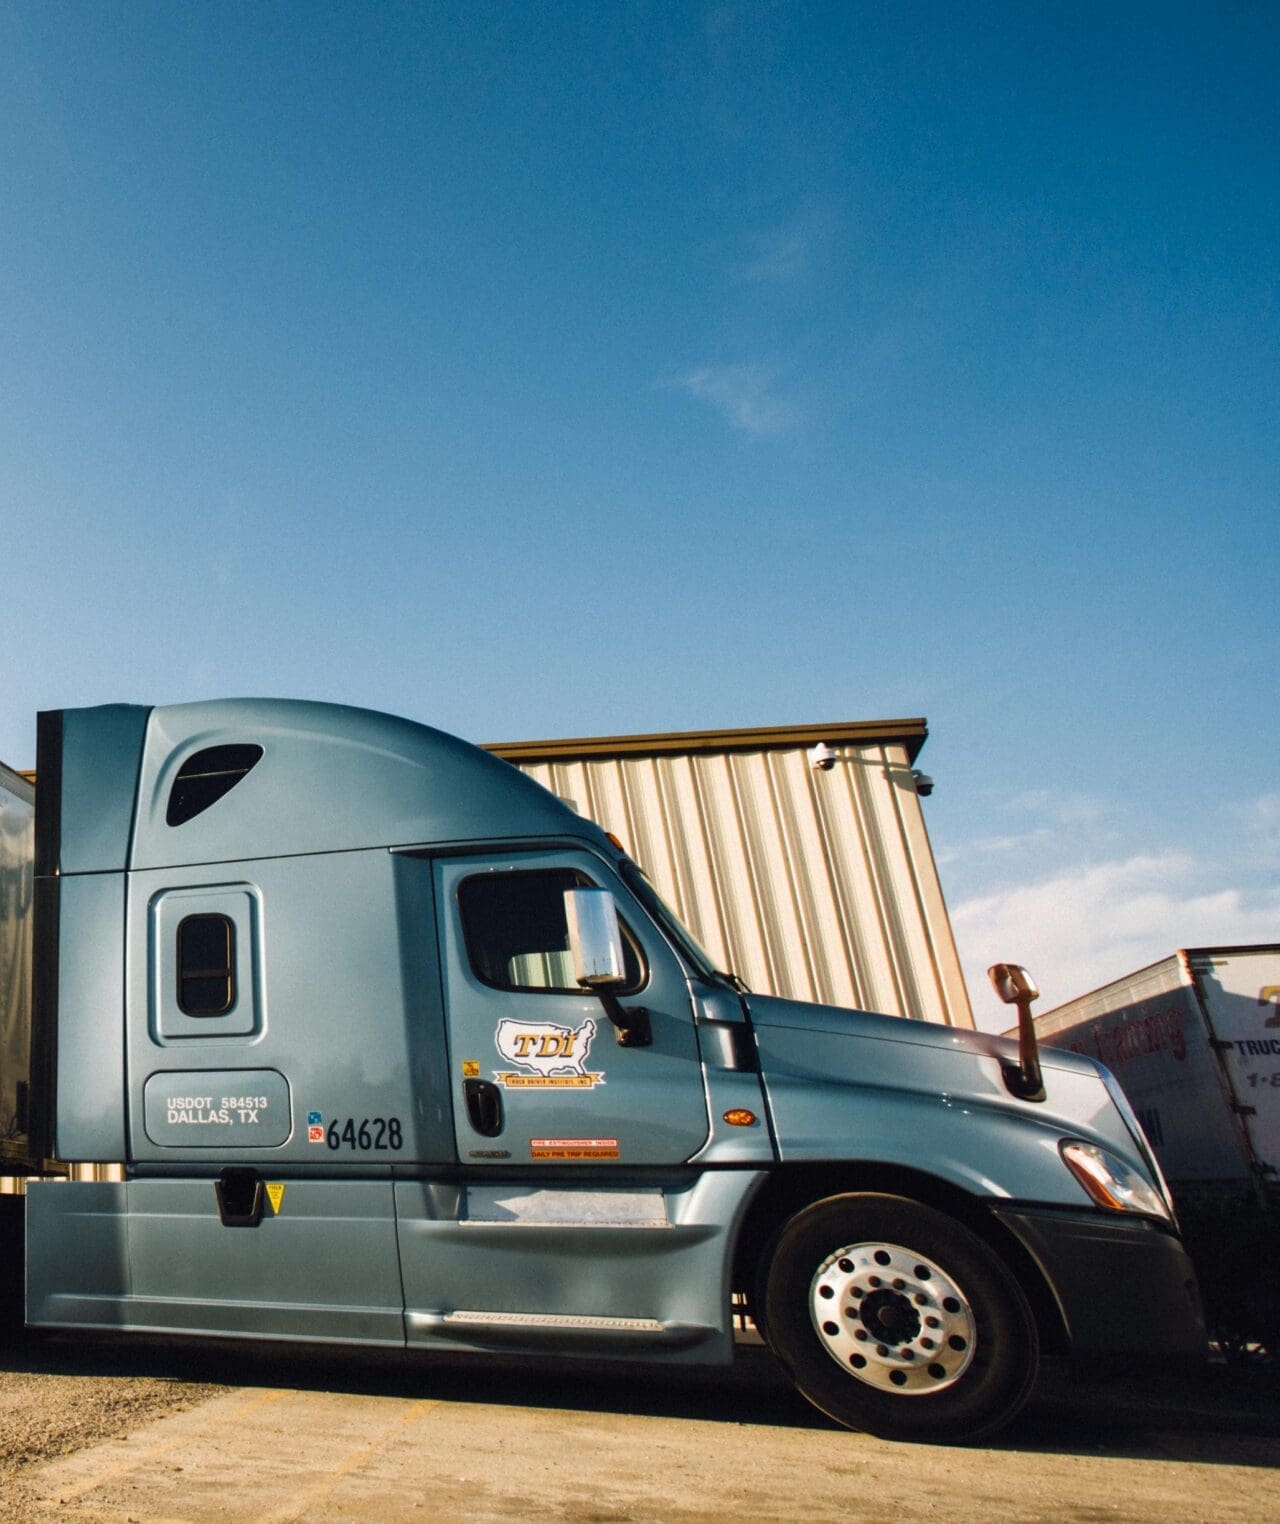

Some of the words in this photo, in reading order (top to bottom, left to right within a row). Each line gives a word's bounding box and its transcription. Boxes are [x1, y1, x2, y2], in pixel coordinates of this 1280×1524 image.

[513, 1032, 579, 1058] TDI
[167, 1097, 214, 1110] USDOT
[221, 1096, 268, 1110] 584513
[167, 1109, 234, 1126] DALLAS,
[237, 1108, 259, 1124] TX
[326, 1117, 403, 1150] 64628
